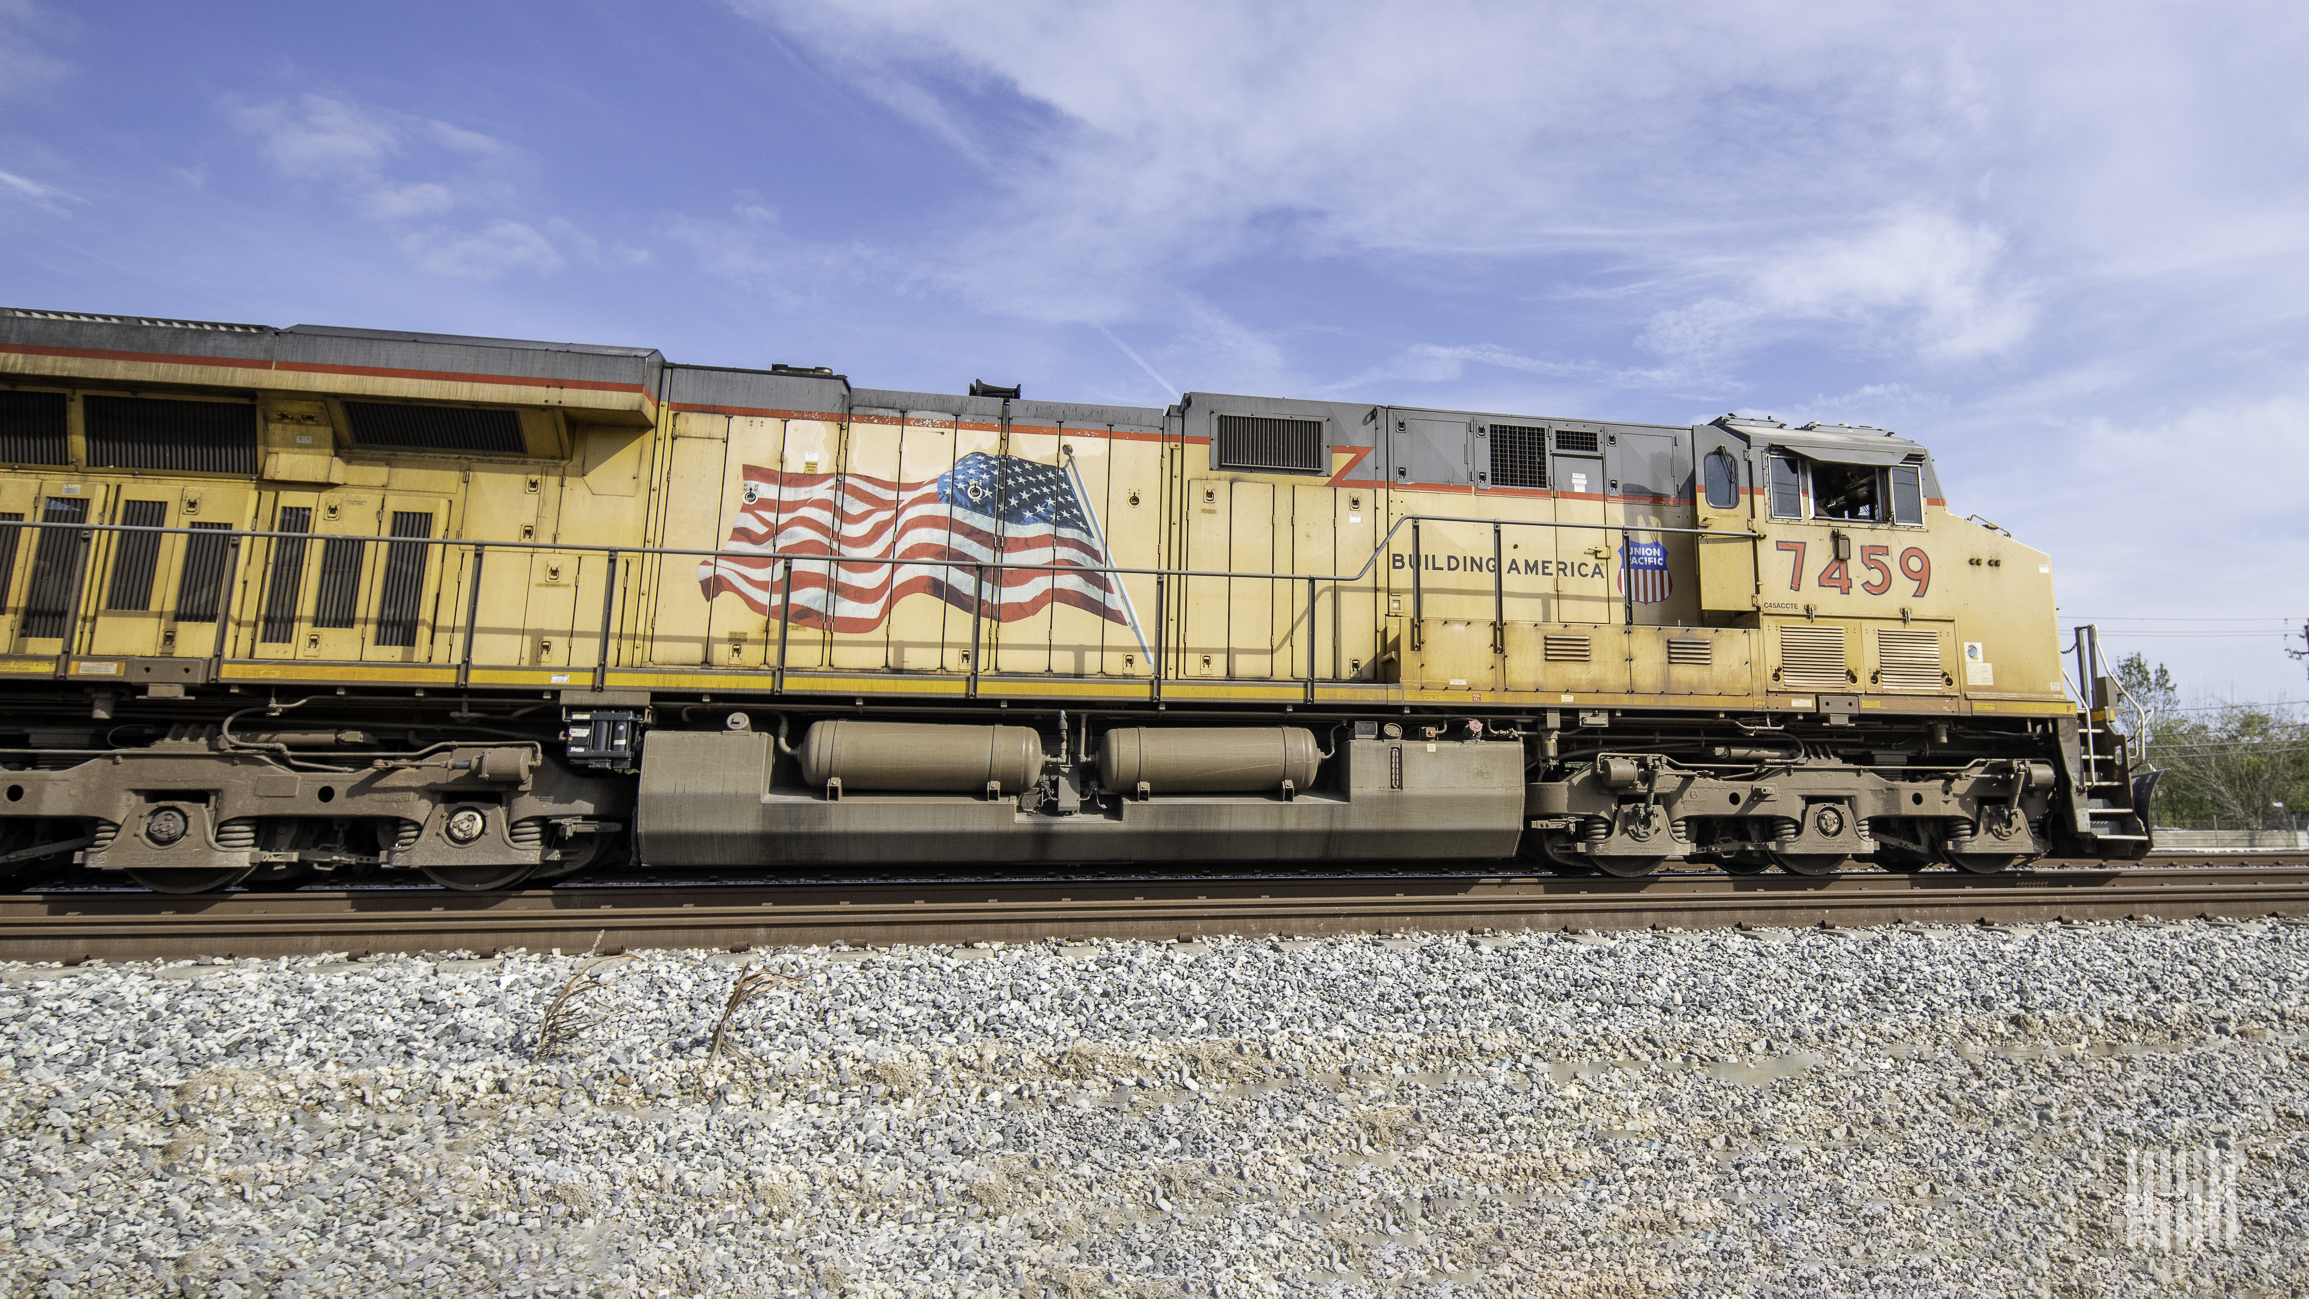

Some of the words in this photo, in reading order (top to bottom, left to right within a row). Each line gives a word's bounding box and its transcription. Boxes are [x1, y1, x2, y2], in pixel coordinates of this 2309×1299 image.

[1392, 553, 1497, 573] BUILDING
[1630, 556, 1664, 566] ACIFIC
[1775, 540, 1931, 598] 7459
